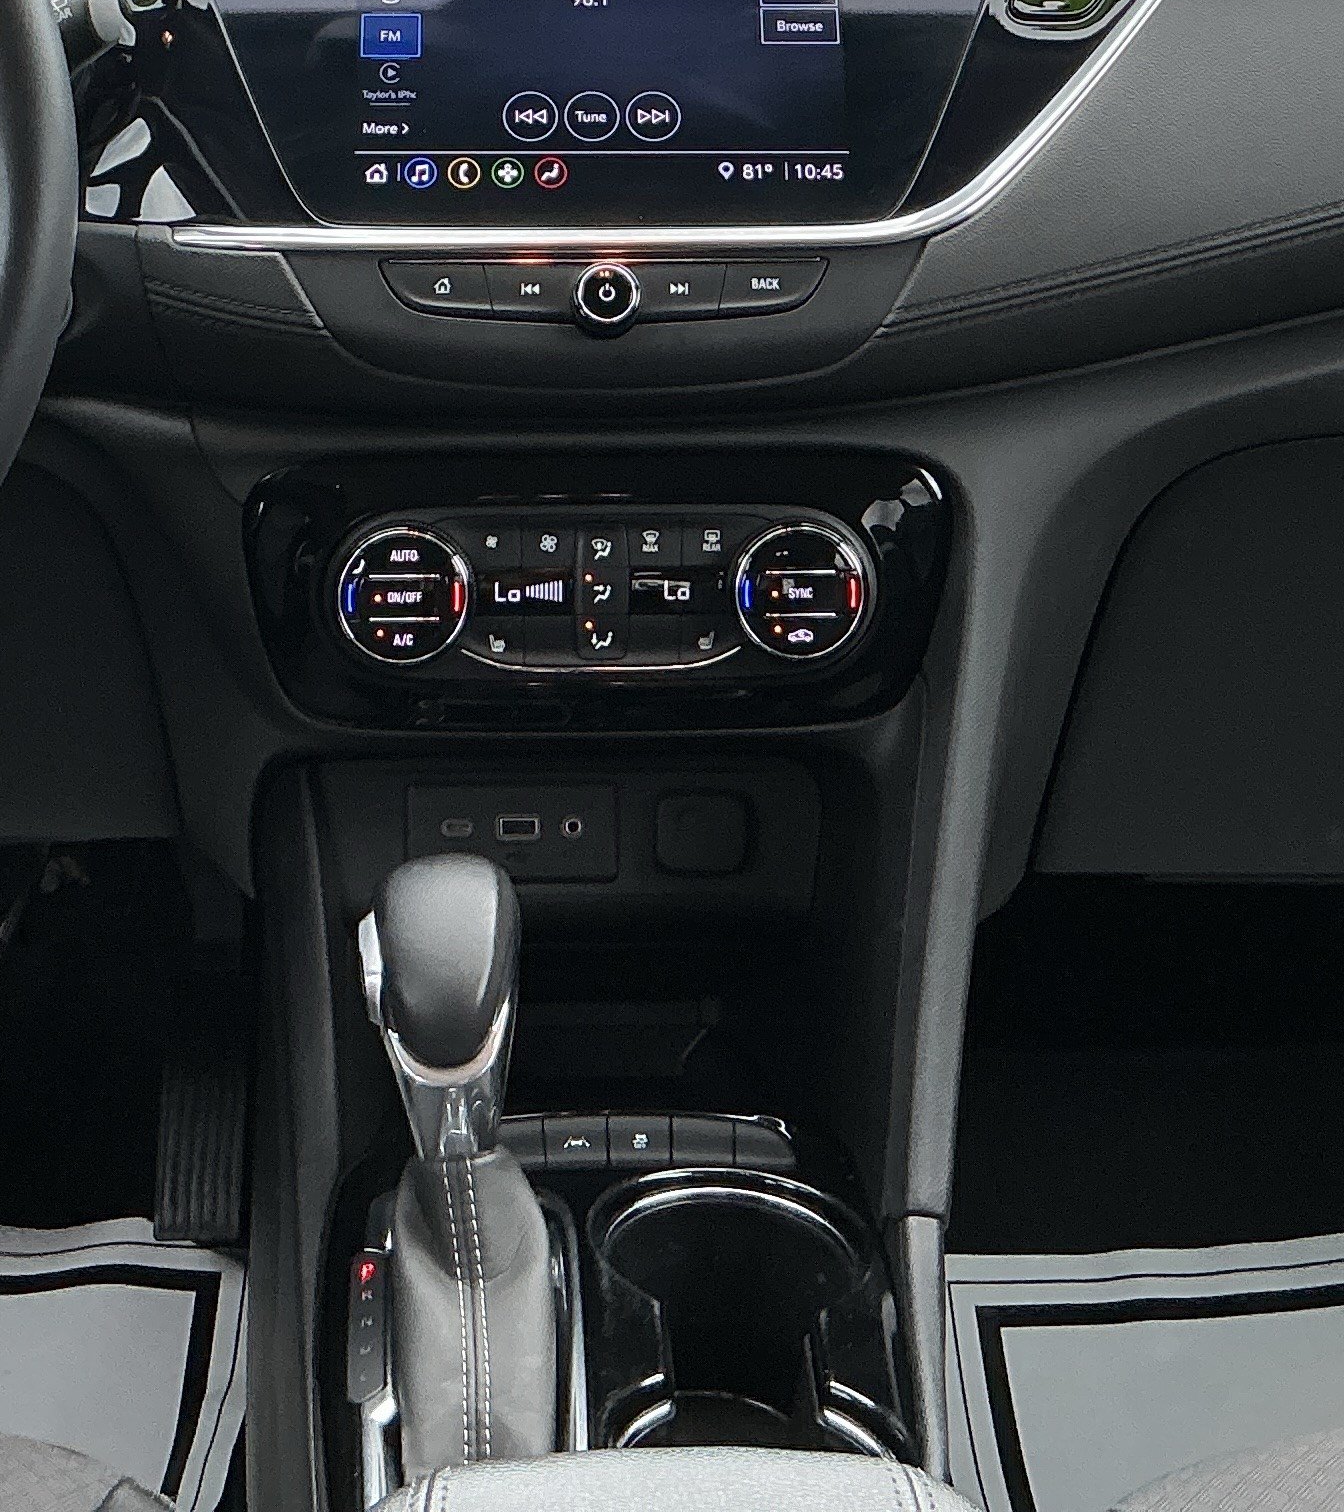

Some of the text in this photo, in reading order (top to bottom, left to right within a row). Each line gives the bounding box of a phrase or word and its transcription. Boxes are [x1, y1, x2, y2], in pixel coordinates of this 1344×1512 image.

[776, 20, 824, 33] Browse
[379, 29, 401, 43] FM
[574, 110, 607, 123] Tune
[362, 122, 399, 135] More
[794, 163, 844, 180] 10:45
[750, 277, 781, 290] BACK
[389, 549, 420, 562] AUTO
[387, 590, 423, 604] ON/OFF
[787, 586, 814, 599] SYNC
[392, 633, 414, 647] A/C
[360, 1262, 375, 1284] P
